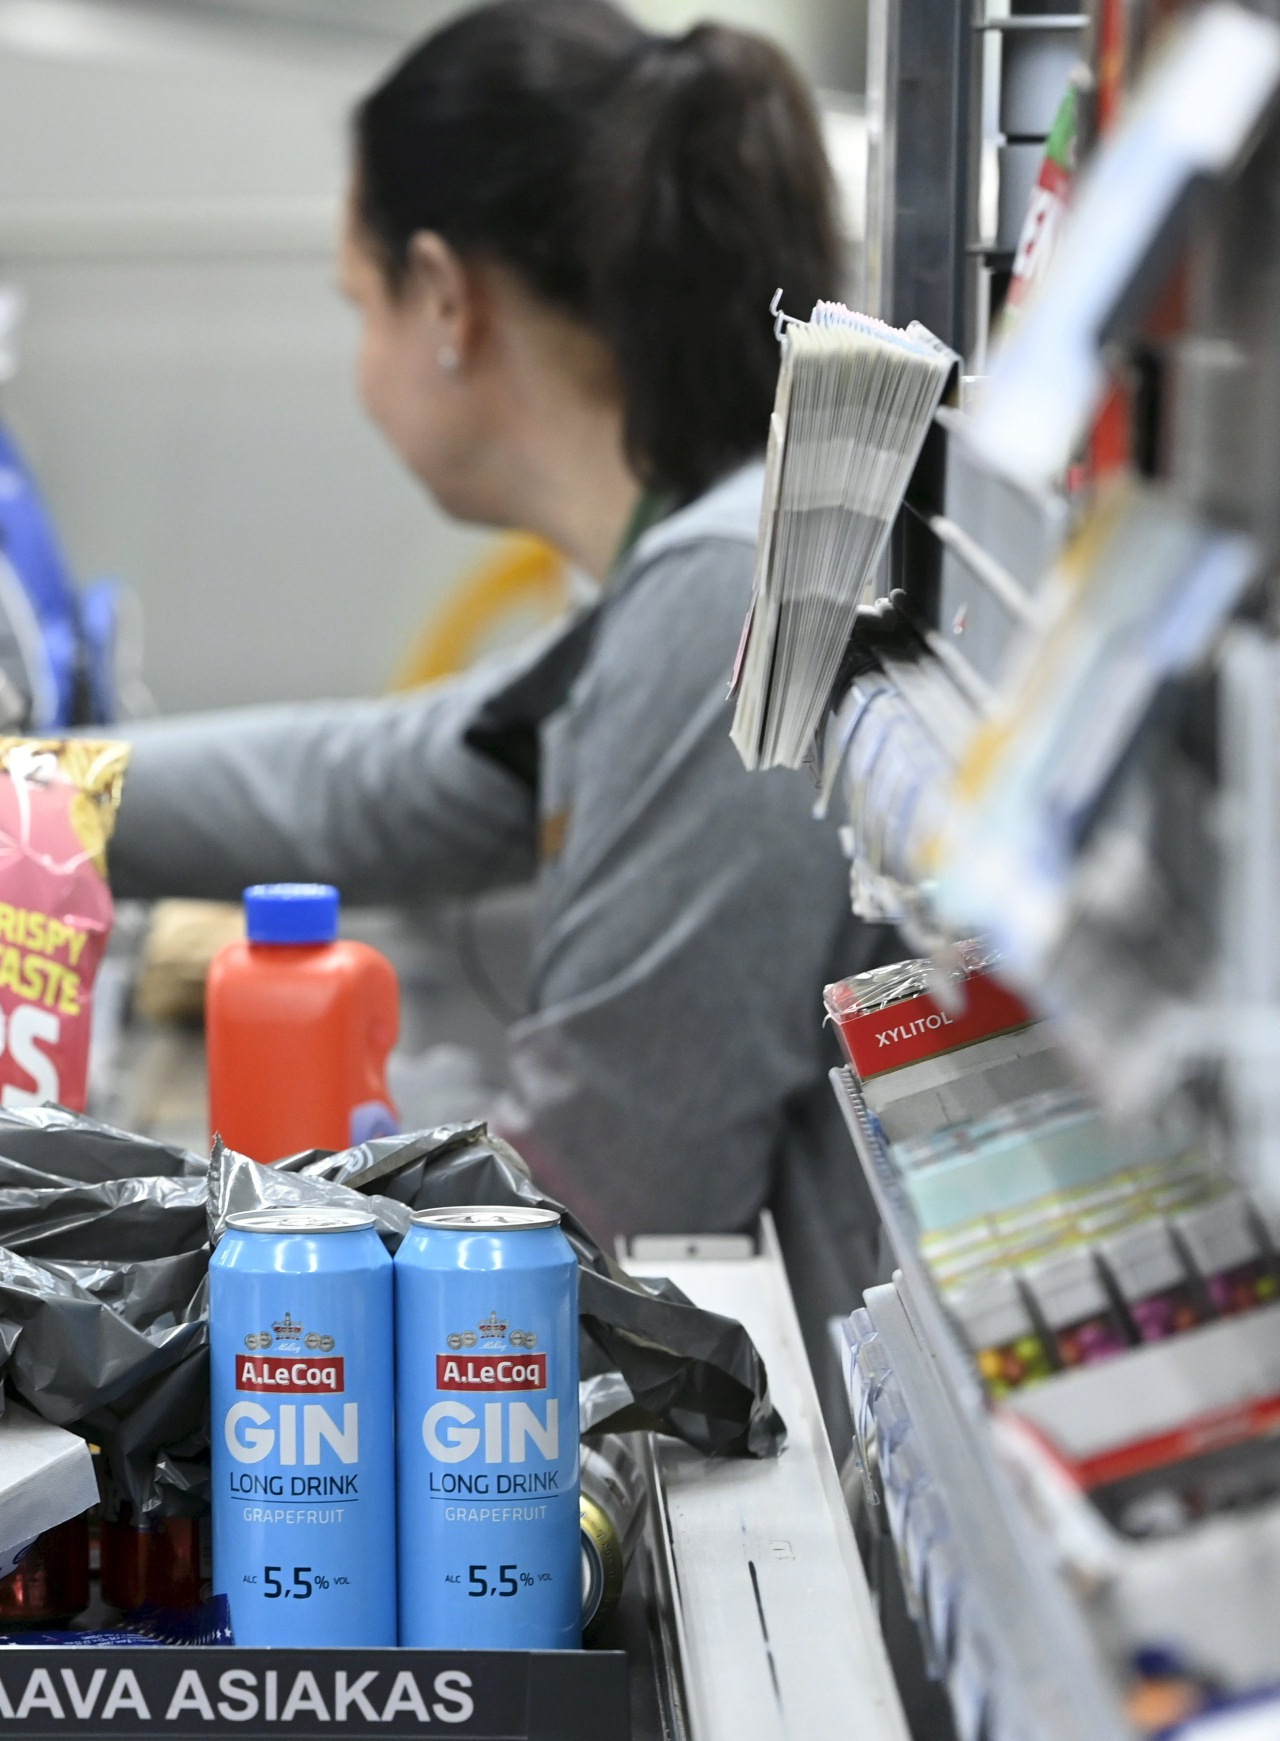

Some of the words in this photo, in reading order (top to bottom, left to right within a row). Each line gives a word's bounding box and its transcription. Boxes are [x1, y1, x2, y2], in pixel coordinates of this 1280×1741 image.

[874, 1011, 954, 1048] XYLITOL
[224, 1400, 359, 1466] GIN
[422, 1398, 560, 1464] GIN
[230, 1471, 283, 1495] LONG
[291, 1474, 358, 1496] DRINK
[429, 1471, 488, 1494] LONG
[496, 1470, 560, 1494] DRINK
[243, 1507, 345, 1524] GRAPEFRUIT
[445, 1505, 548, 1522] GRAPEFRUIT
[242, 1575, 258, 1584] ALC
[333, 1576, 351, 1586] VOL
[445, 1574, 461, 1584] ALC
[537, 1573, 553, 1582] VOL
[165, 1669, 475, 1723] ASIAKAS
